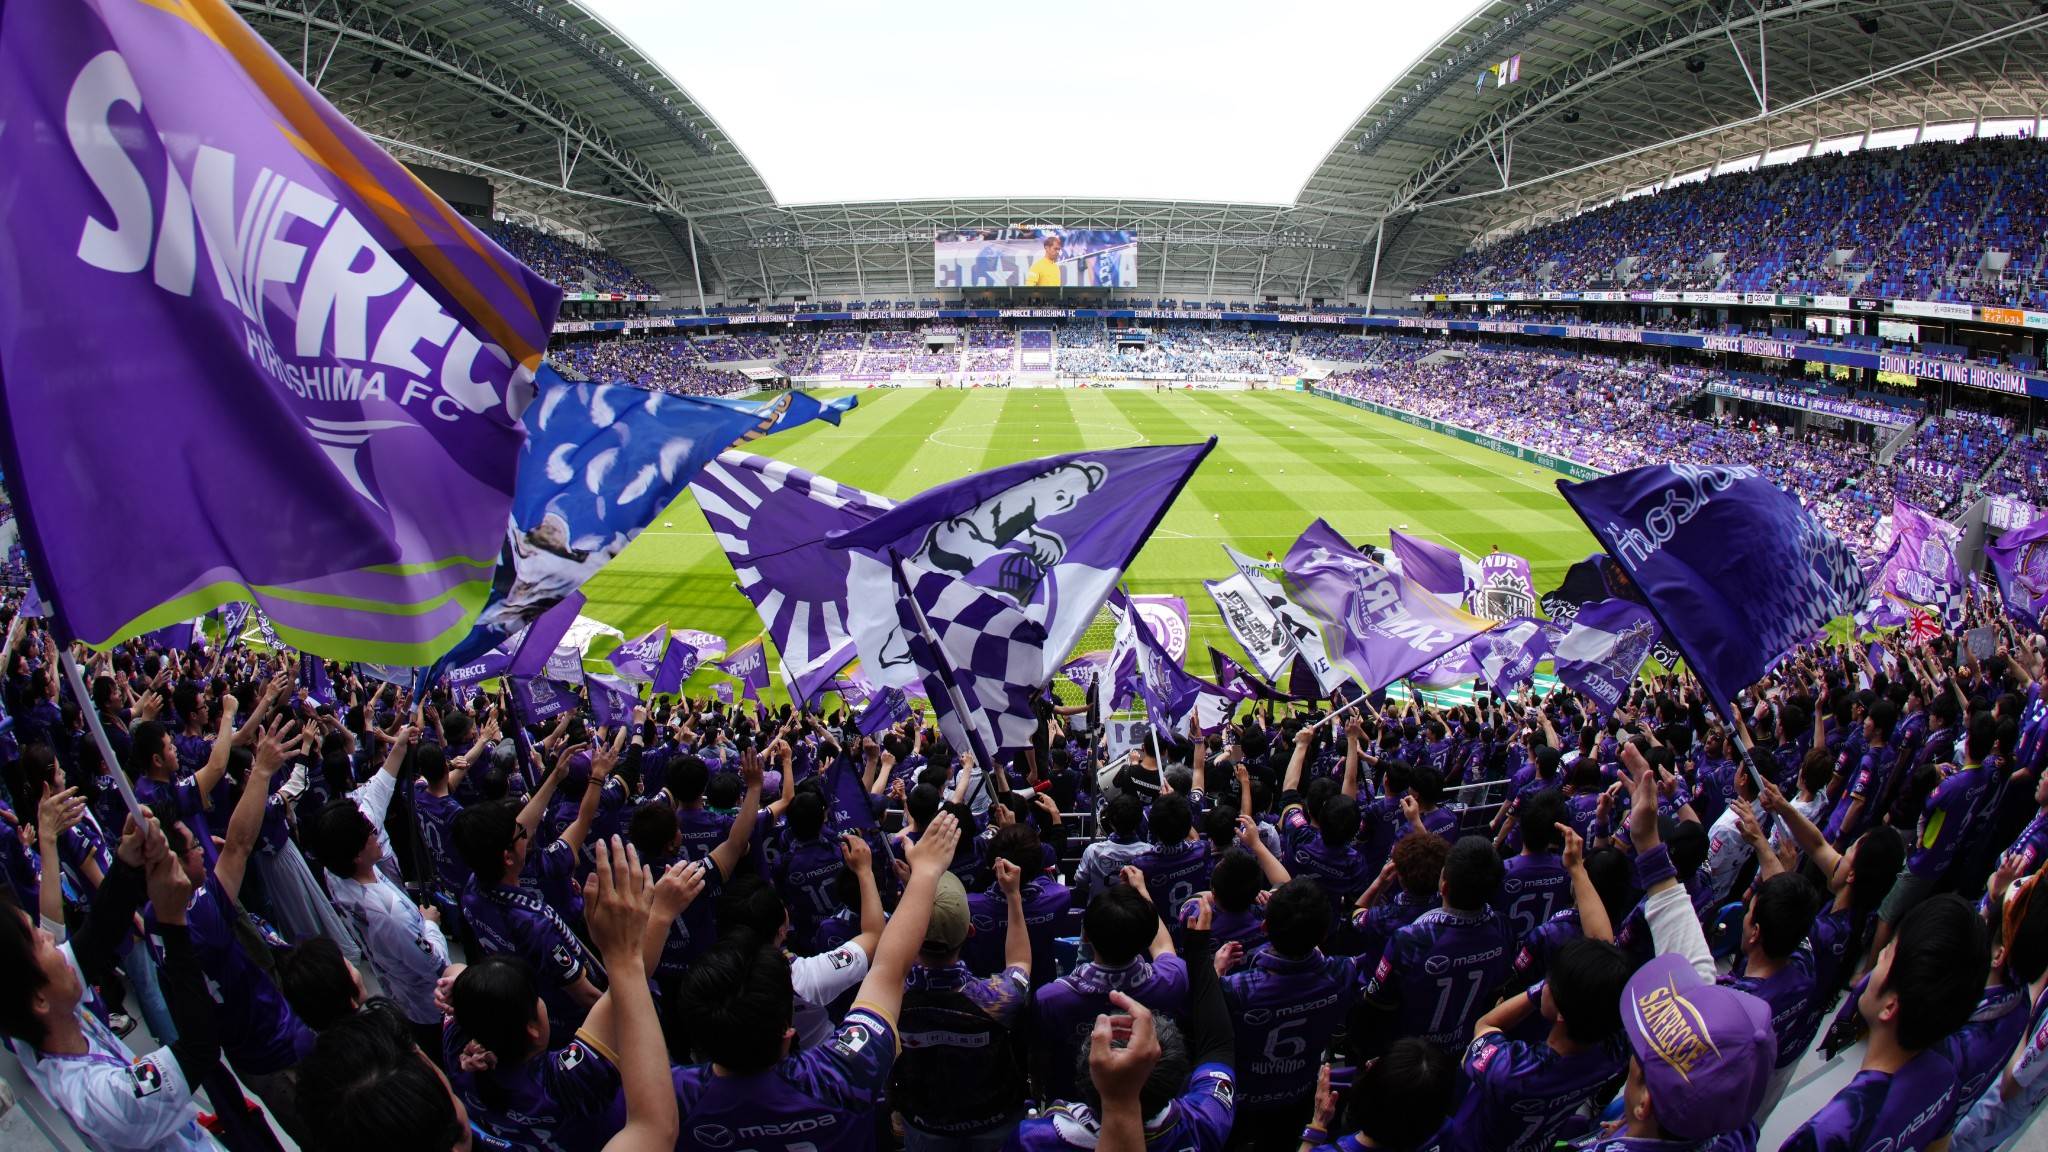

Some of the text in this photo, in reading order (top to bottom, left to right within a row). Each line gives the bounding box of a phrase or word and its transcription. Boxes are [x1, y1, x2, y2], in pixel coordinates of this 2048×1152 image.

[728, 315, 756, 324] SANFRECCE
[757, 314, 788, 323] HIROSHIMA
[852, 310, 939, 320] EDION PEACE WING HIROSHIMA
[999, 310, 1031, 318] SANFRECCE
[1134, 310, 1222, 320] EDION PEACE WING HIROSHIMA
[1278, 314, 1346, 324] SANFRECCE HIROSHIMA FC
[1566, 327, 1642, 343] EDION PEACE WING HIROSHIMA
[1702, 337, 1796, 358] SANFRECCE HIROSHIMA FC
[243, 321, 465, 422] HIROSHIMA FC
[1879, 355, 2027, 395] EDION PEACE WING HIROSHIMA
[1990, 496, 2032, 531] 前進
[1523, 875, 1564, 888] mazda
[1168, 881, 1193, 920] 8
[1452, 946, 1503, 968] mazda
[1275, 993, 1338, 1017] mazda
[1263, 1017, 1307, 1061] 6
[1638, 986, 1709, 1074] SANFRECCE
[737, 1113, 837, 1139] mazda
